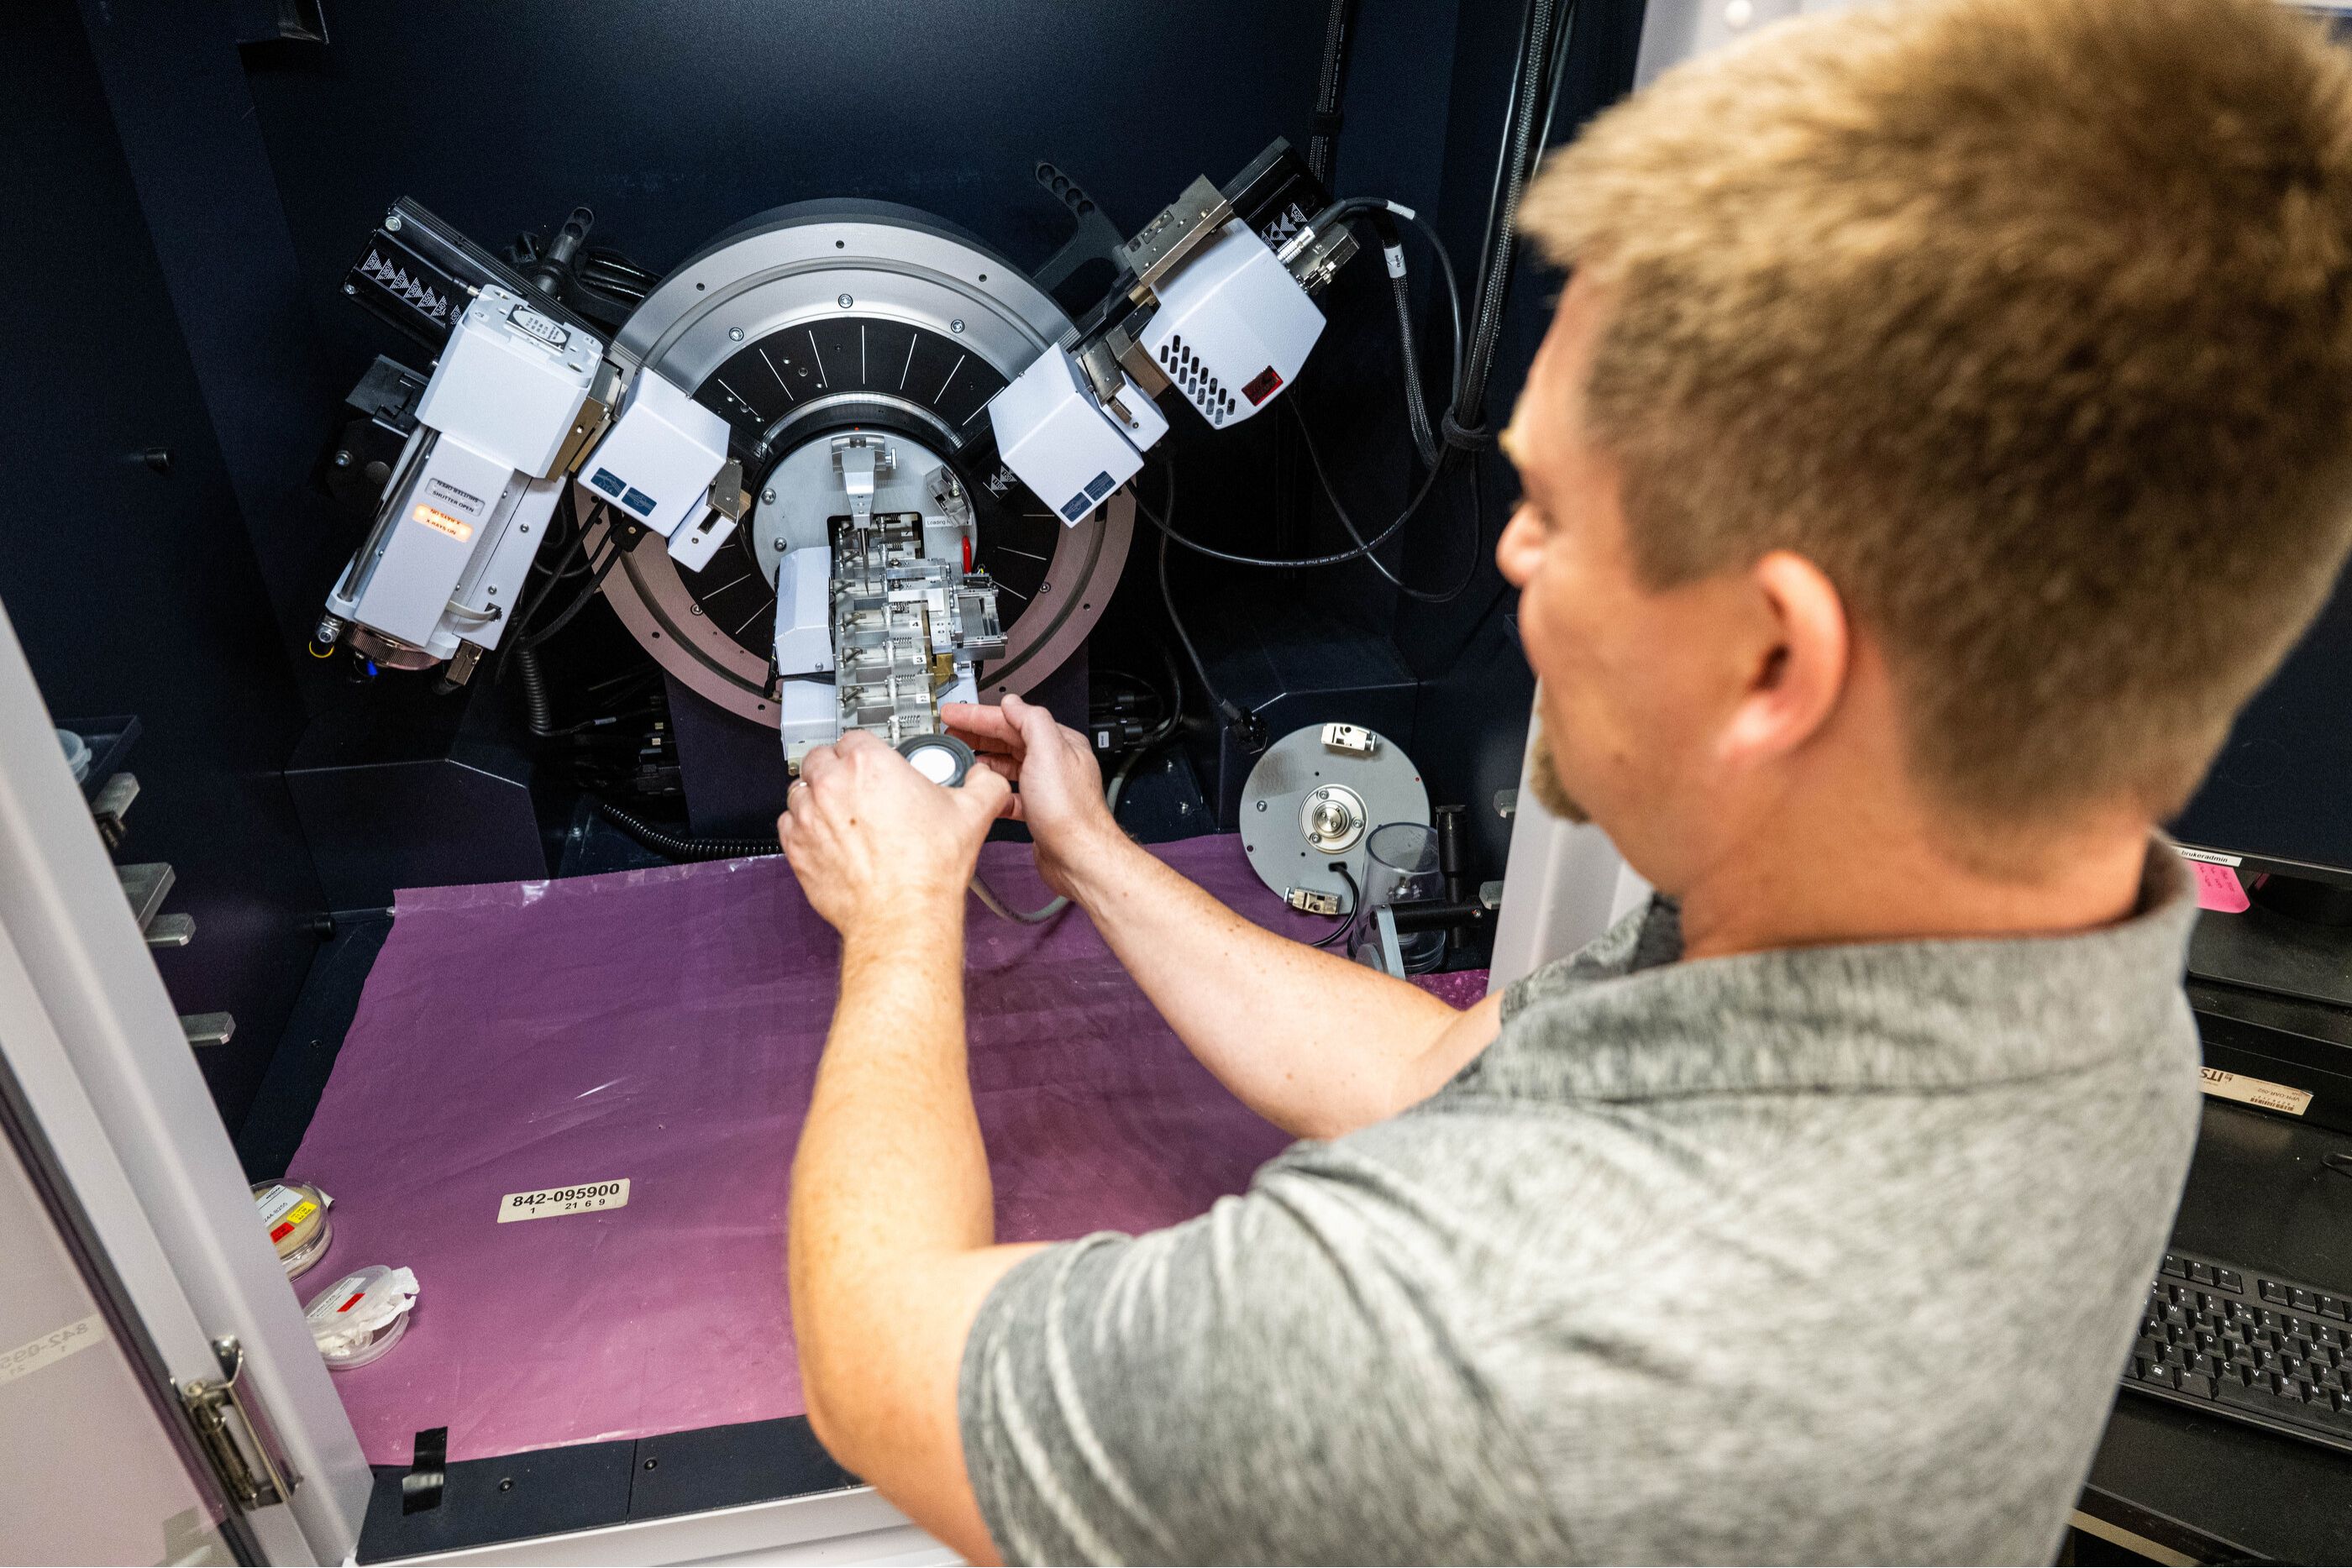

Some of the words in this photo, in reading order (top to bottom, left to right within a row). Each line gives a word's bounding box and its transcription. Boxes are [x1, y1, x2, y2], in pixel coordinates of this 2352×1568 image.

[368, 257, 378, 268] 390
[381, 265, 391, 277] 380
[395, 275, 405, 286] 370
[409, 285, 419, 296] 360
[423, 294, 433, 305] 350
[436, 303, 446, 314] 340
[1002, 470, 1013, 480] 120
[993, 479, 1003, 489] 110
[433, 490, 459, 505] SHUTTER
[459, 502, 475, 512] OPEN
[427, 519, 446, 531] X-RAYS
[916, 655, 923, 663] 3
[2181, 850, 2229, 863] brukeradmin
[2199, 1068, 2225, 1083] ITS
[512, 1183, 620, 1207] 842-095900
[585, 1199, 592, 1208] 6
